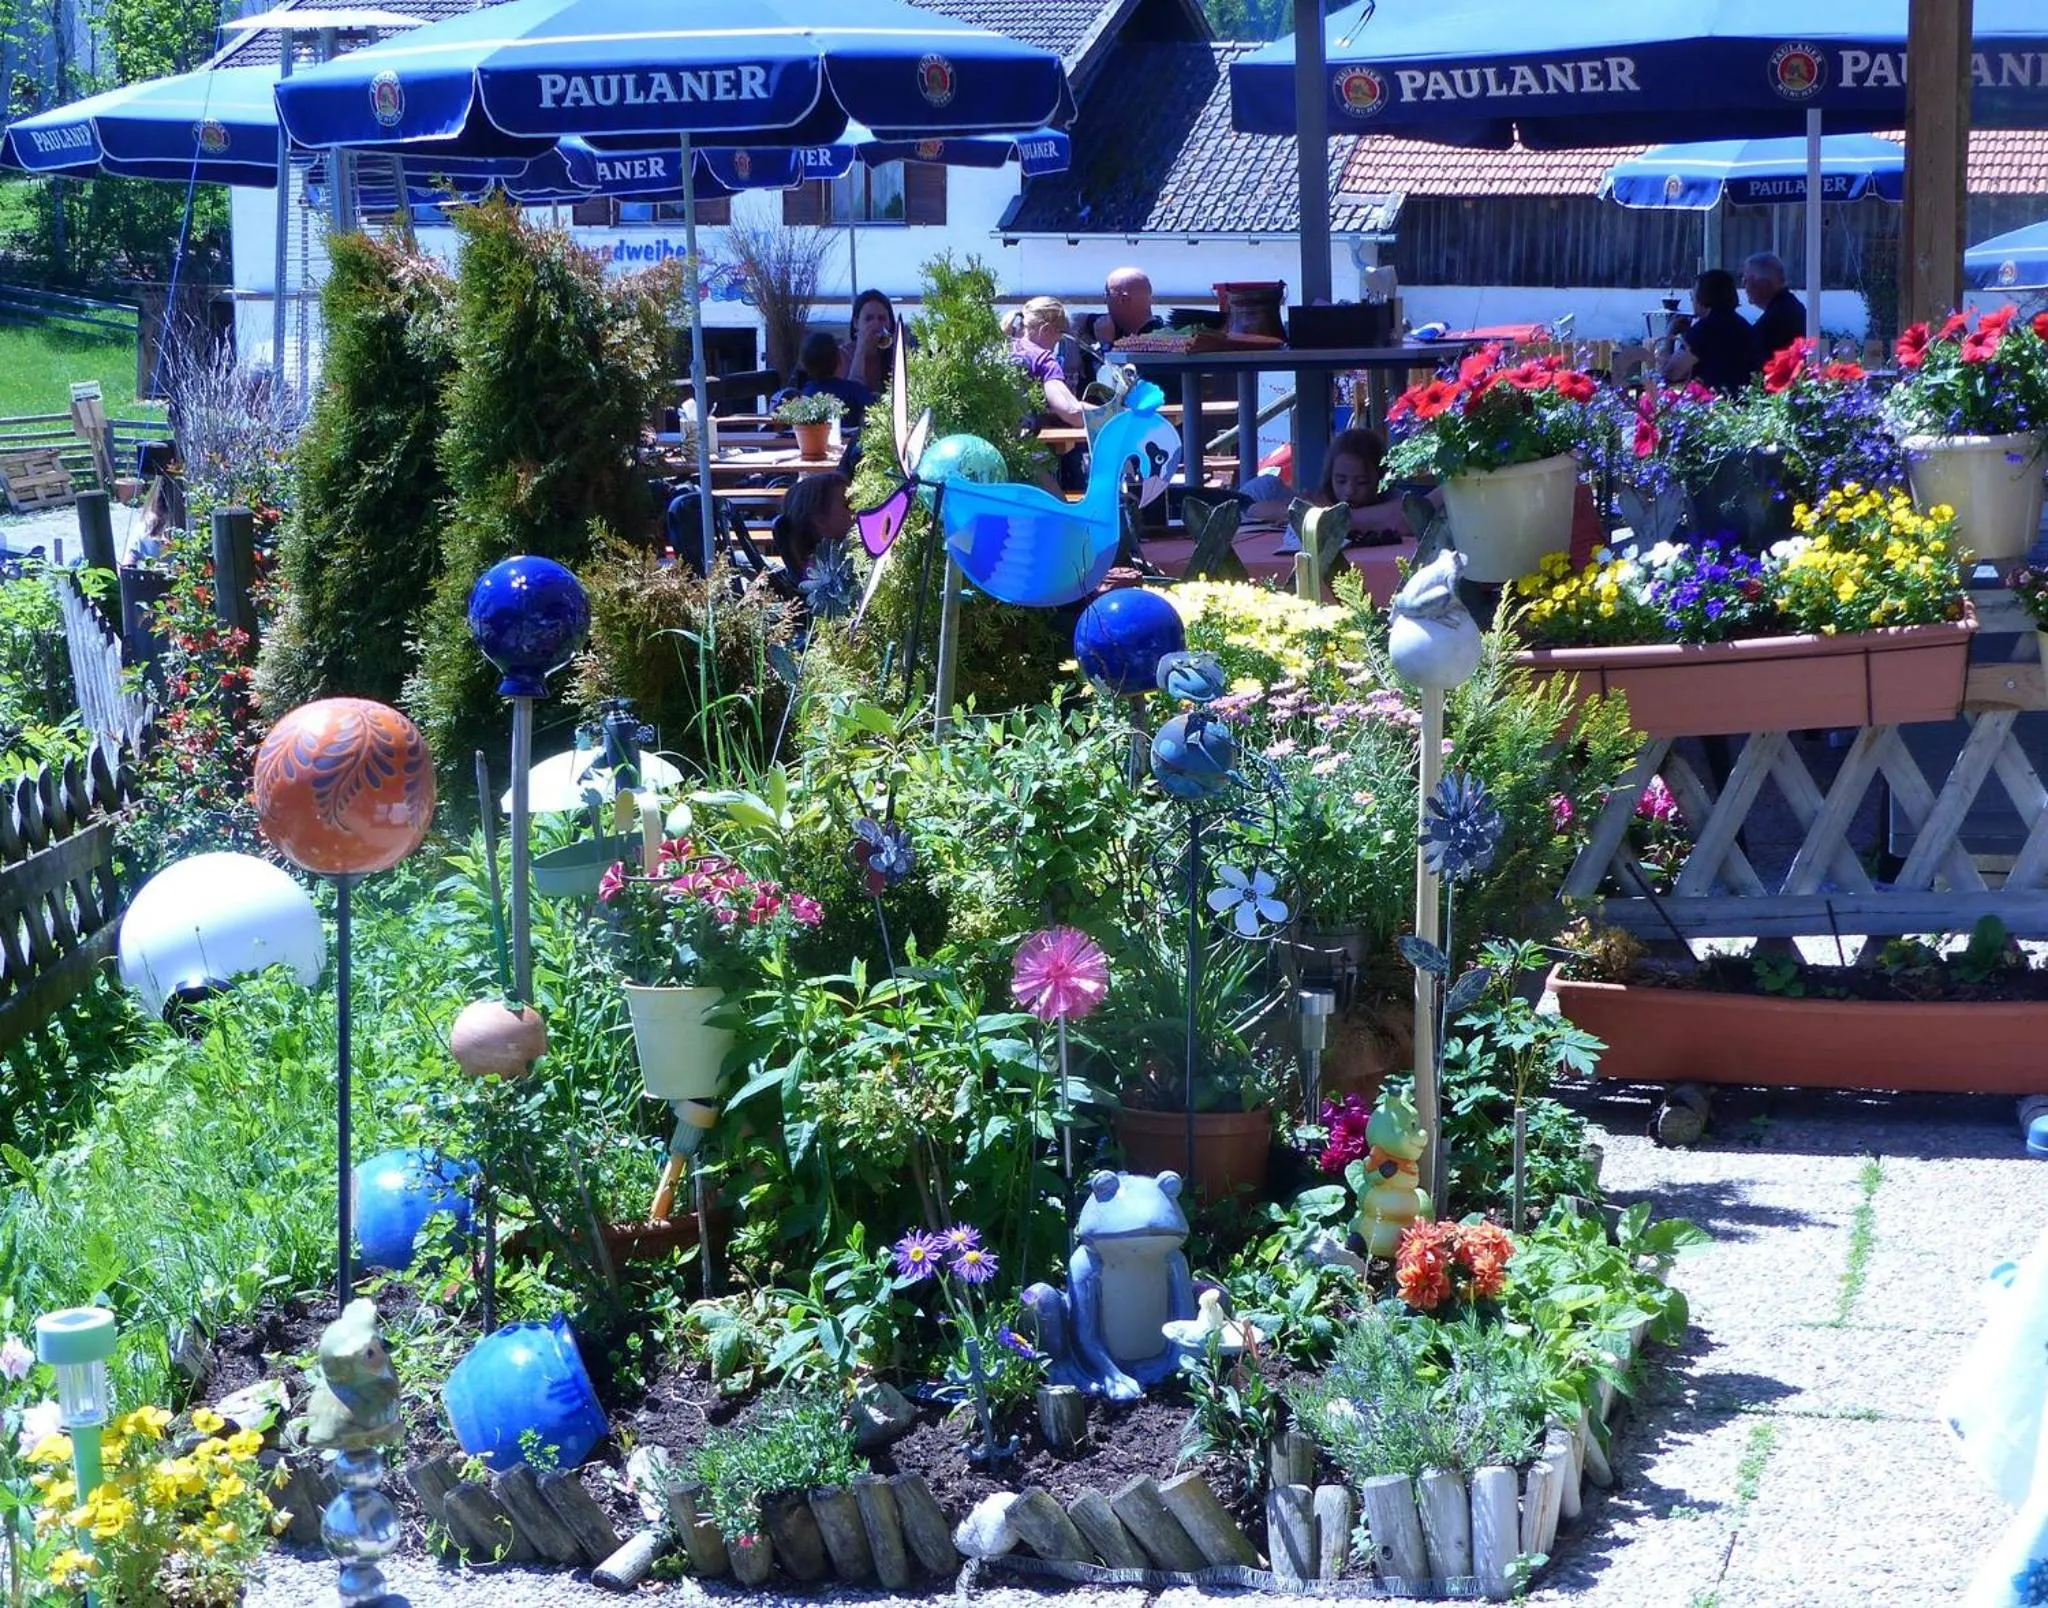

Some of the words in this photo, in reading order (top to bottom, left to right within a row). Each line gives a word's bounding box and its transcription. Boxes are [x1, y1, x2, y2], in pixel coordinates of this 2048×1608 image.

[537, 65, 769, 108] PAULANER
[1394, 56, 1641, 103] PAULANER
[30, 125, 92, 153] PAULANER
[597, 156, 667, 181] ANER
[1749, 176, 1848, 196] PAULAER
